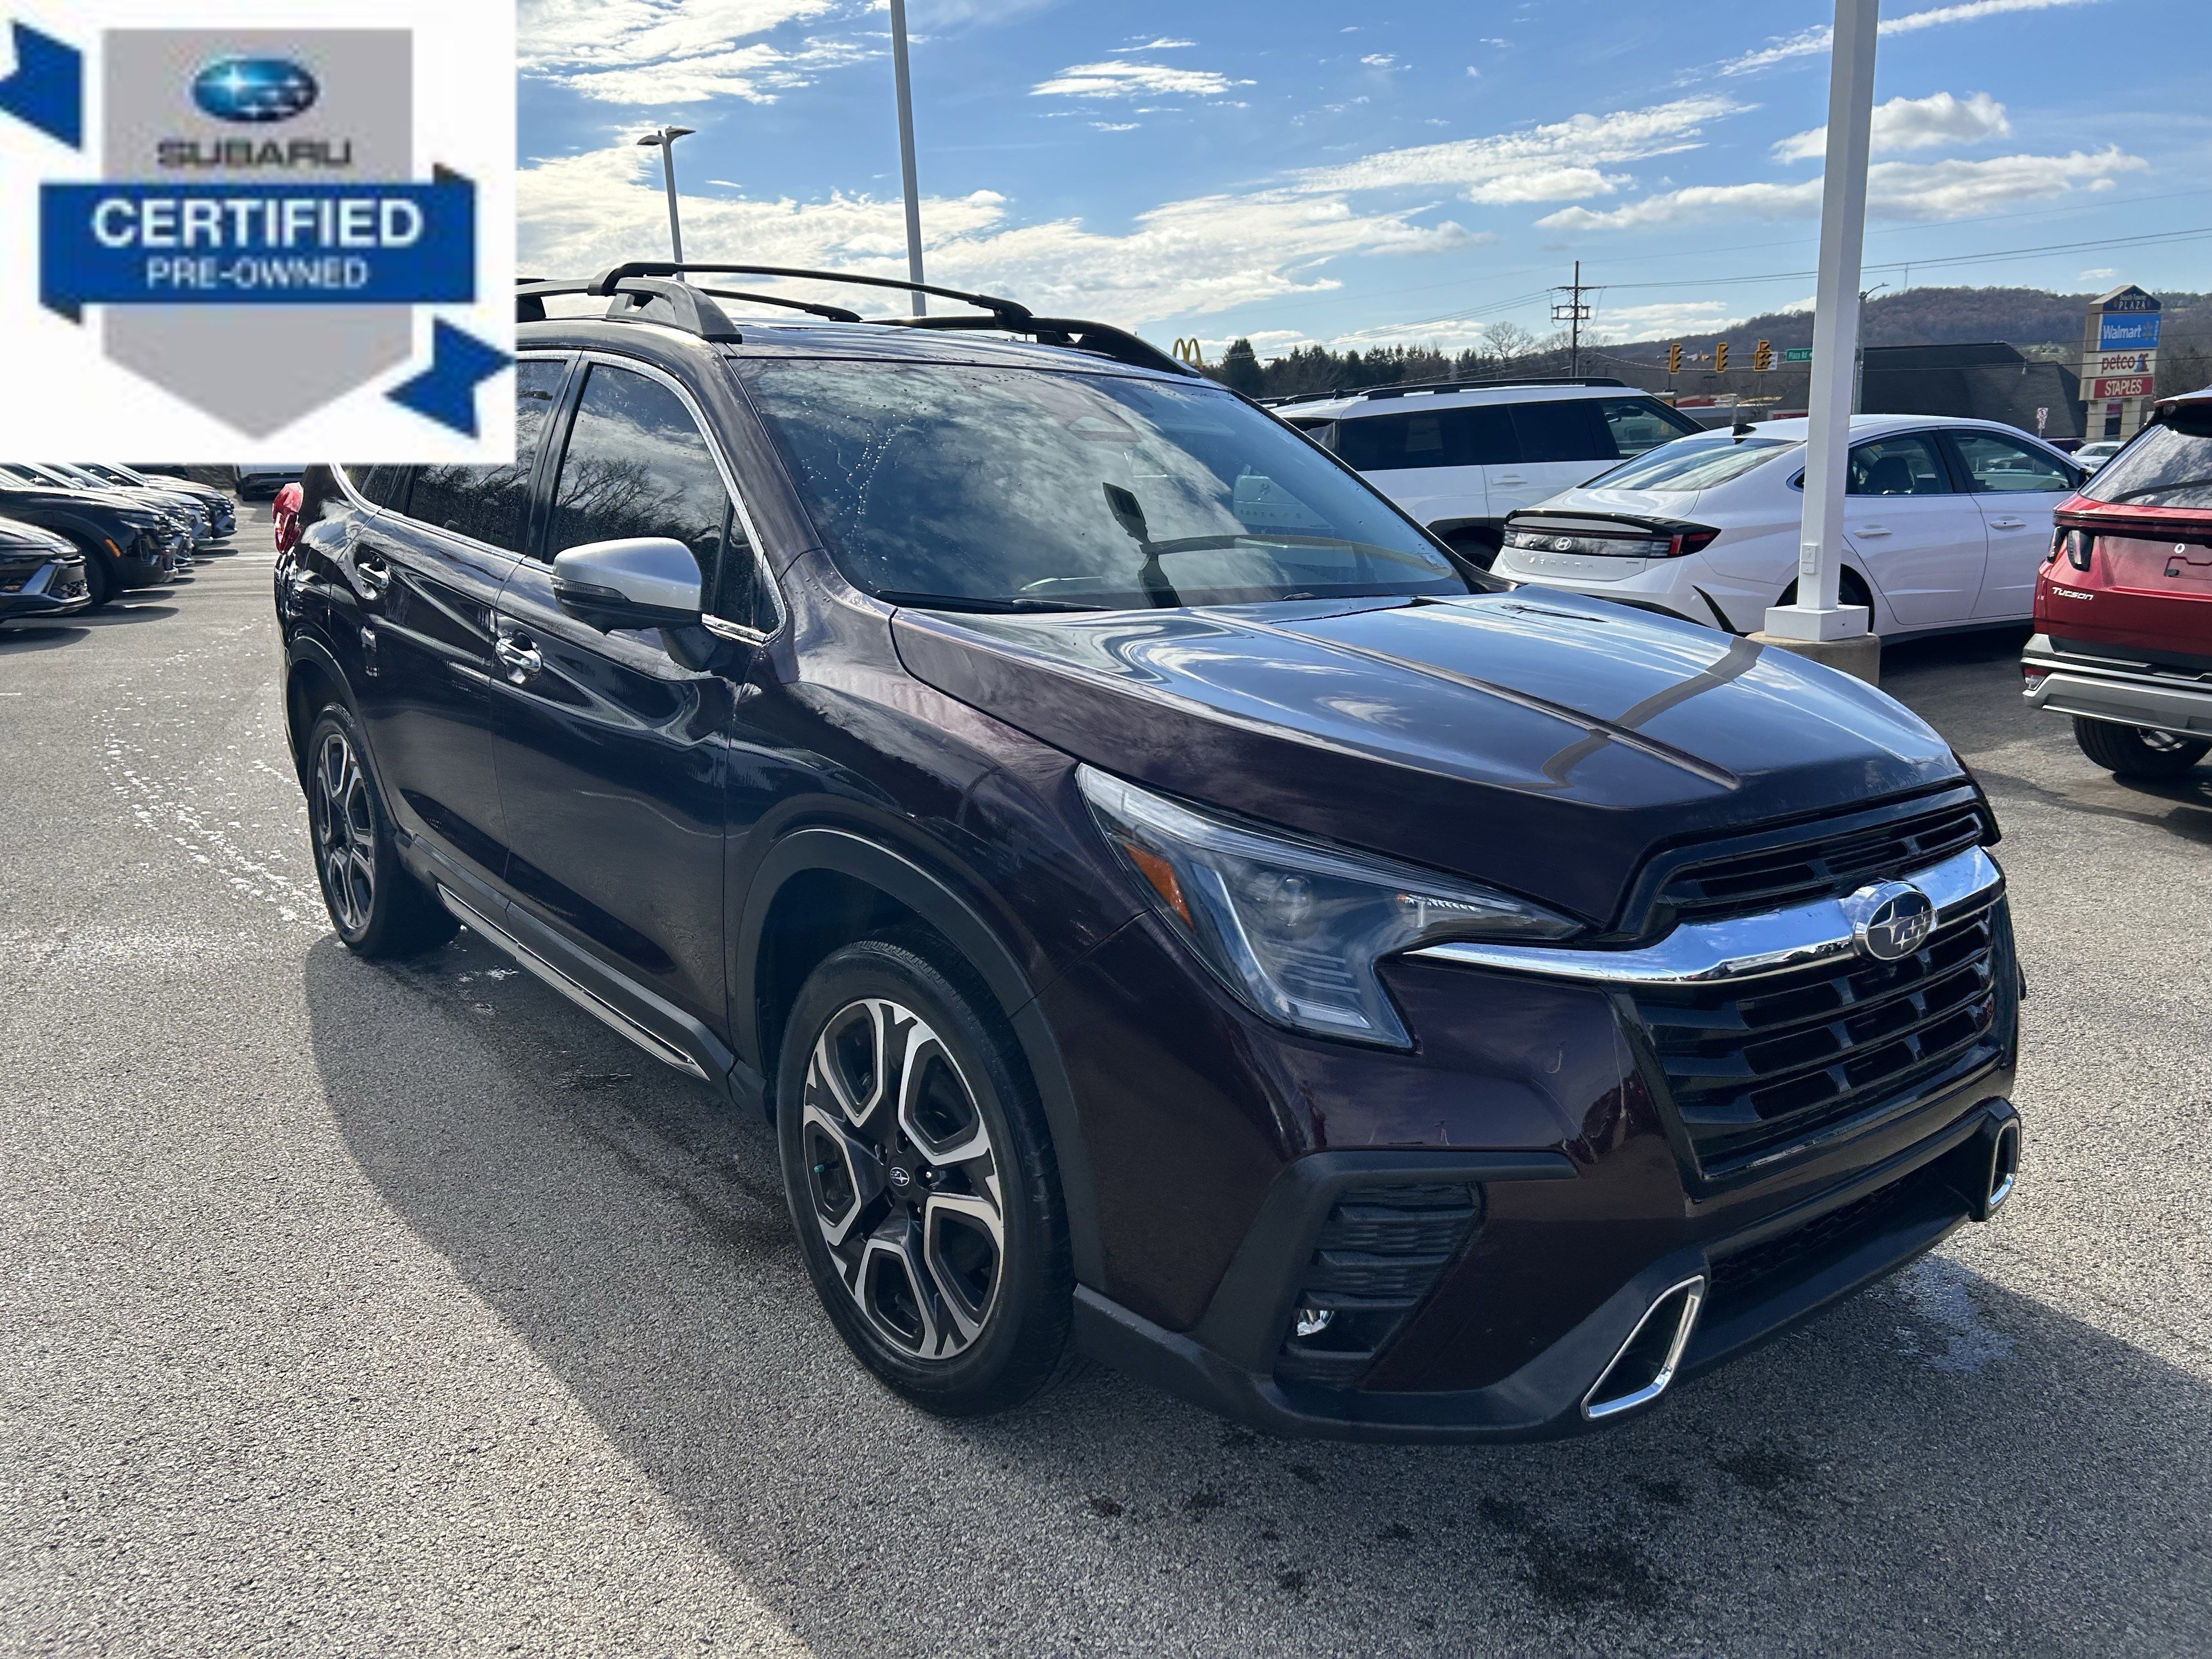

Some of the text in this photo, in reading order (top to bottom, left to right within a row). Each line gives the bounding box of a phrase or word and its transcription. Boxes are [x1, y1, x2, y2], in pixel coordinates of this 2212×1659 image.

[2118, 301, 2145, 309] PLAZA
[2103, 324, 2141, 339] Walmart
[2101, 354, 2135, 374] petco
[2105, 379, 2142, 396] STAPLES
